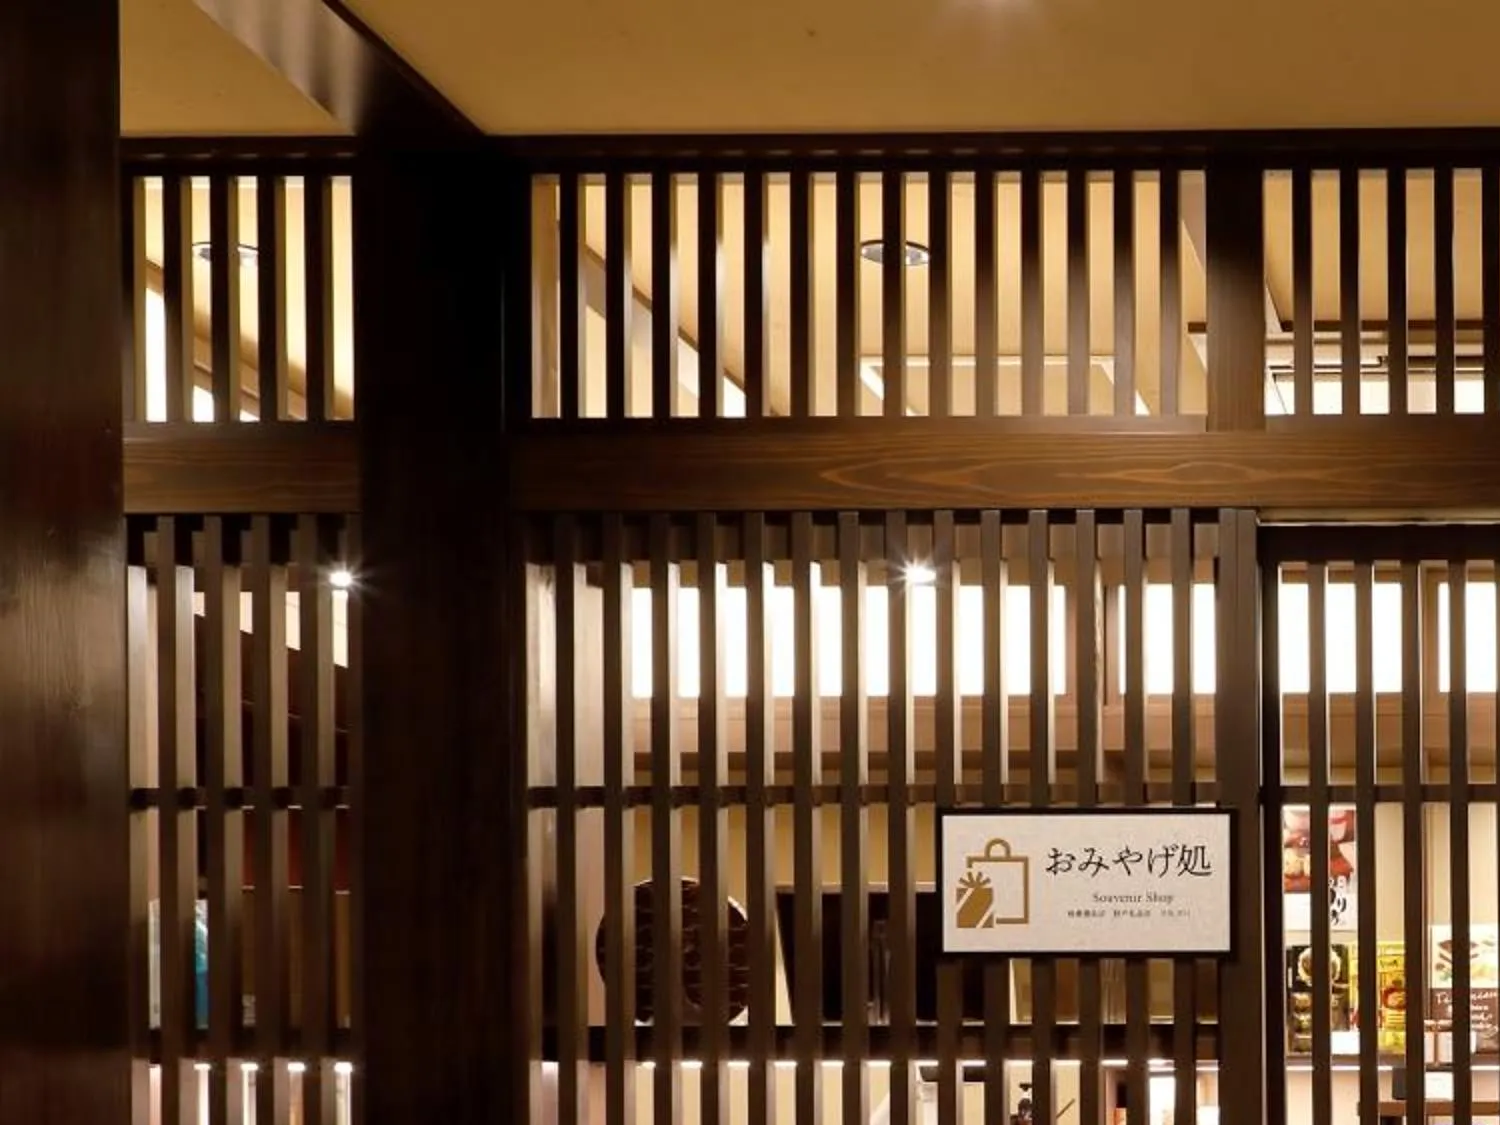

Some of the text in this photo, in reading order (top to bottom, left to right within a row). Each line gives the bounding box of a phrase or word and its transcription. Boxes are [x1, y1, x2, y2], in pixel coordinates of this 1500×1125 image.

[1045, 844, 1212, 878] おみやげ処
[1093, 891, 1174, 904] Souvenir Shop
